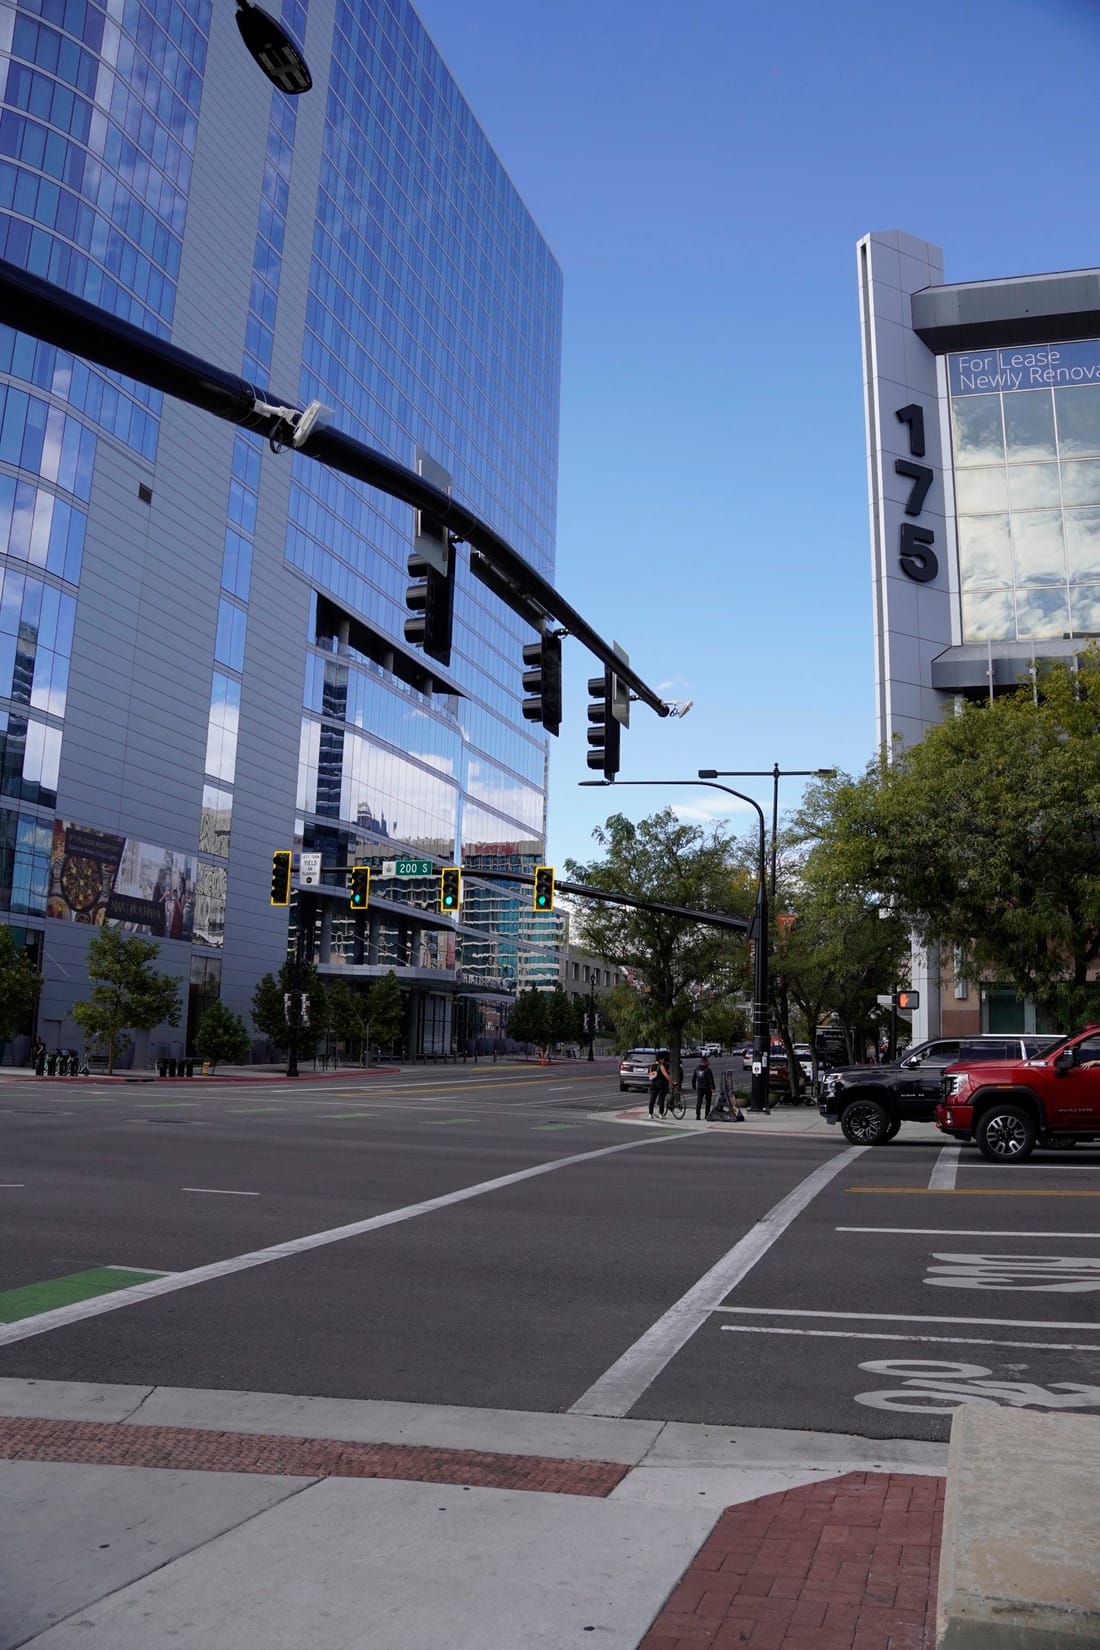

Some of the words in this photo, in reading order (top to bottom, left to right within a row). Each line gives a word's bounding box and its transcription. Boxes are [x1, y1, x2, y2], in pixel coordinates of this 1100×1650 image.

[959, 356, 992, 373] For
[999, 351, 1060, 369] Lease
[960, 369, 1022, 390] Newly
[895, 403, 938, 583] 175
[399, 863, 417, 873] 200
[422, 863, 428, 873] S
